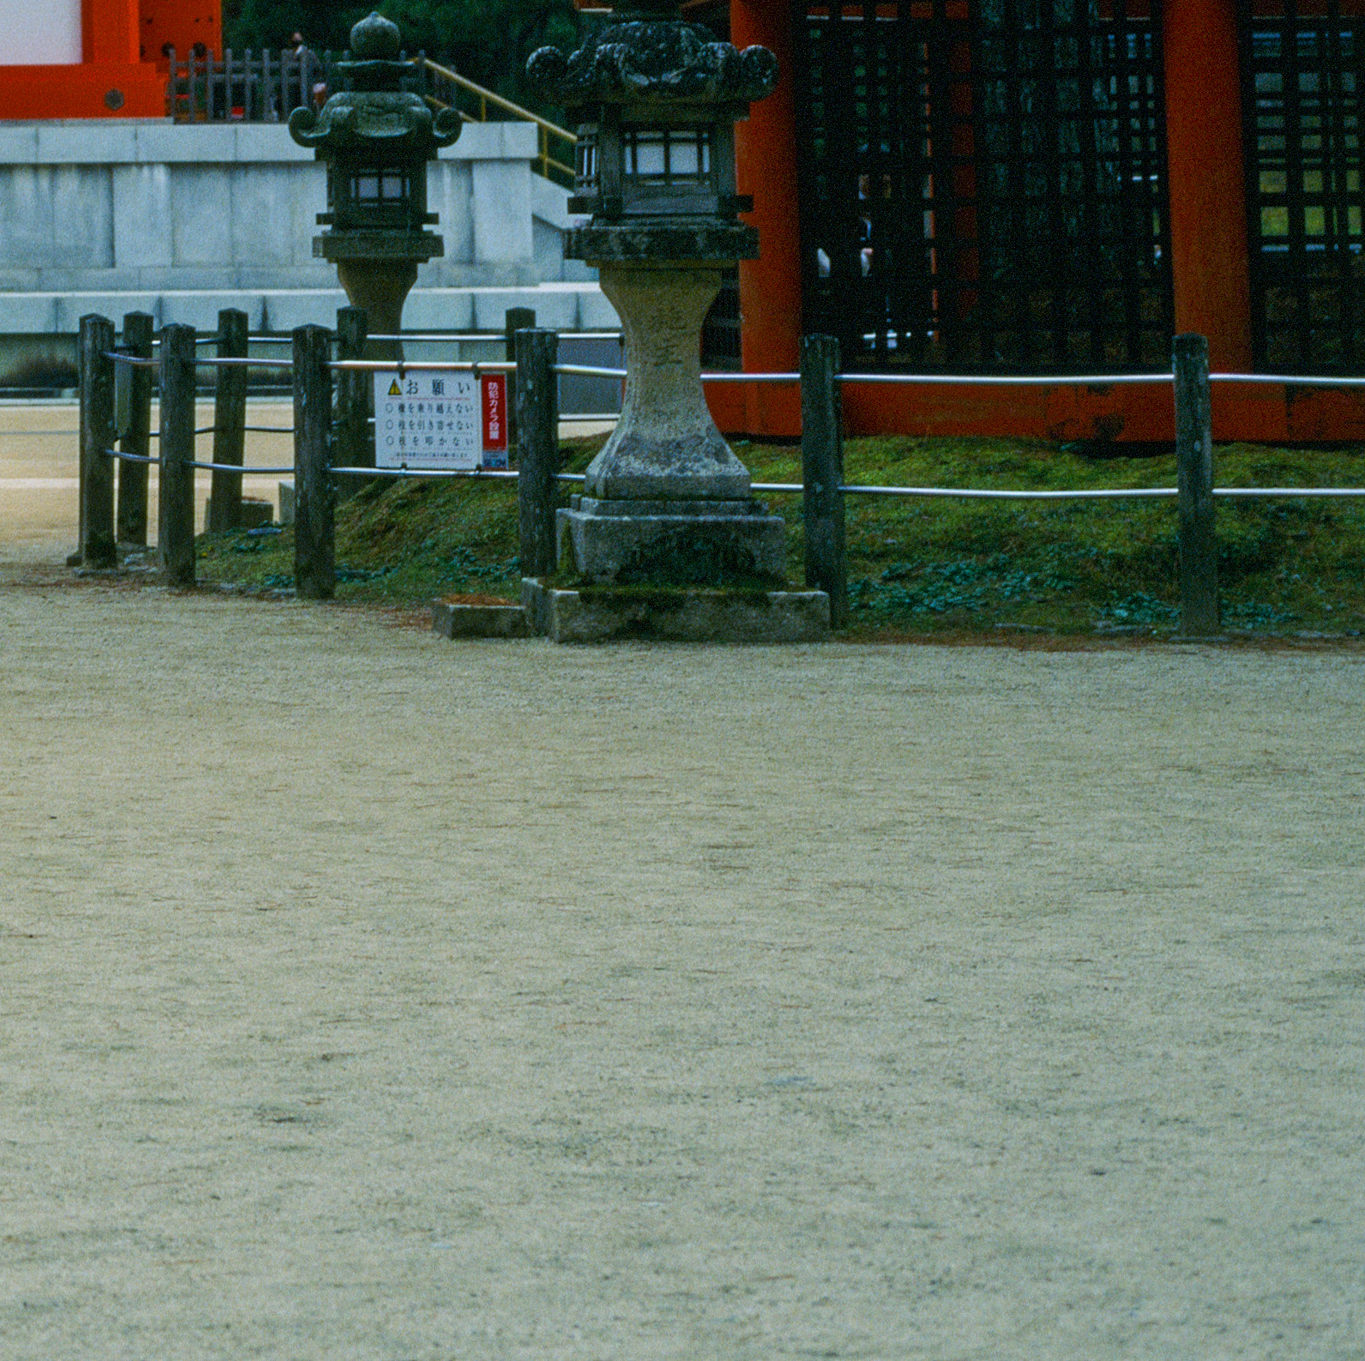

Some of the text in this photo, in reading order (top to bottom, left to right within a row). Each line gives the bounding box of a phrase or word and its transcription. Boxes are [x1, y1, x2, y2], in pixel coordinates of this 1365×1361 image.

[406, 378, 471, 396] お願い
[487, 381, 500, 440] 防犯カメラ設置
